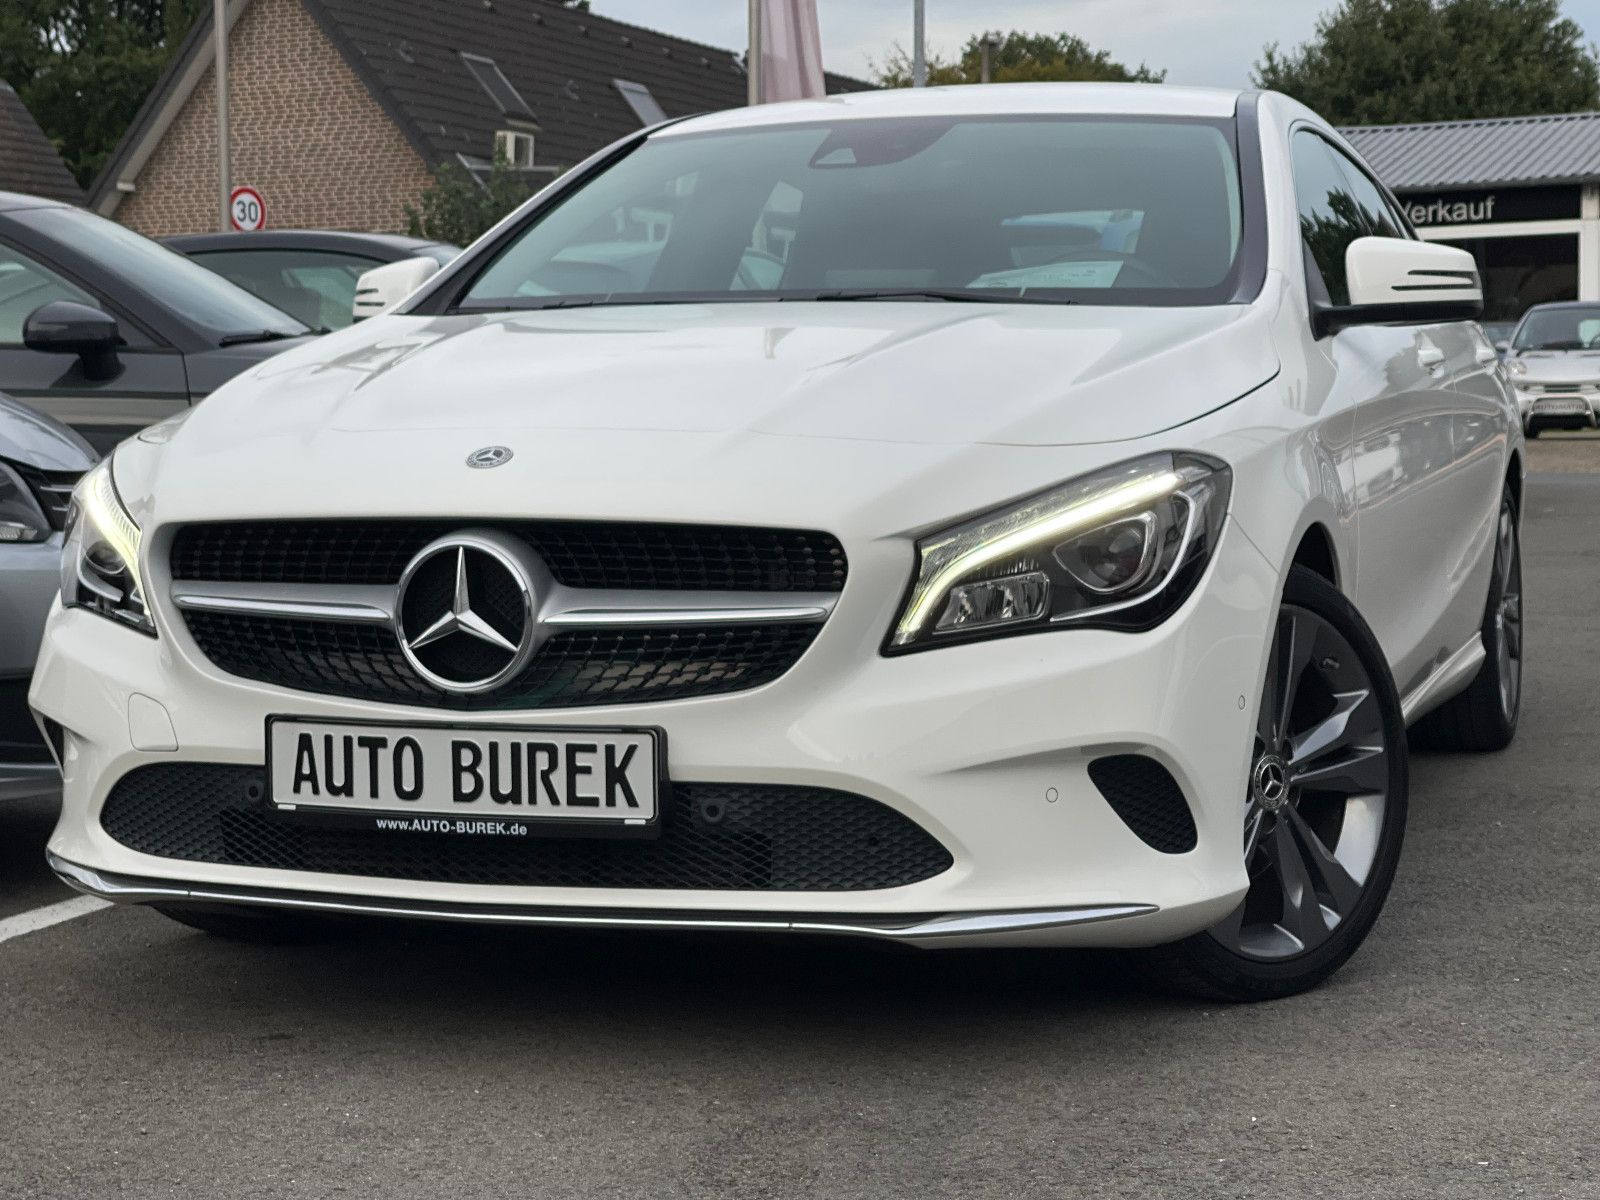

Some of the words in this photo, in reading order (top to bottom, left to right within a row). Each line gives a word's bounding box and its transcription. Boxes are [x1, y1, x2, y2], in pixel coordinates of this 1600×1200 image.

[237, 200, 259, 223] 30
[293, 732, 424, 802] AUTO
[450, 740, 640, 809] BUREK
[376, 818, 528, 836] www.AUTO-BUREK.de
